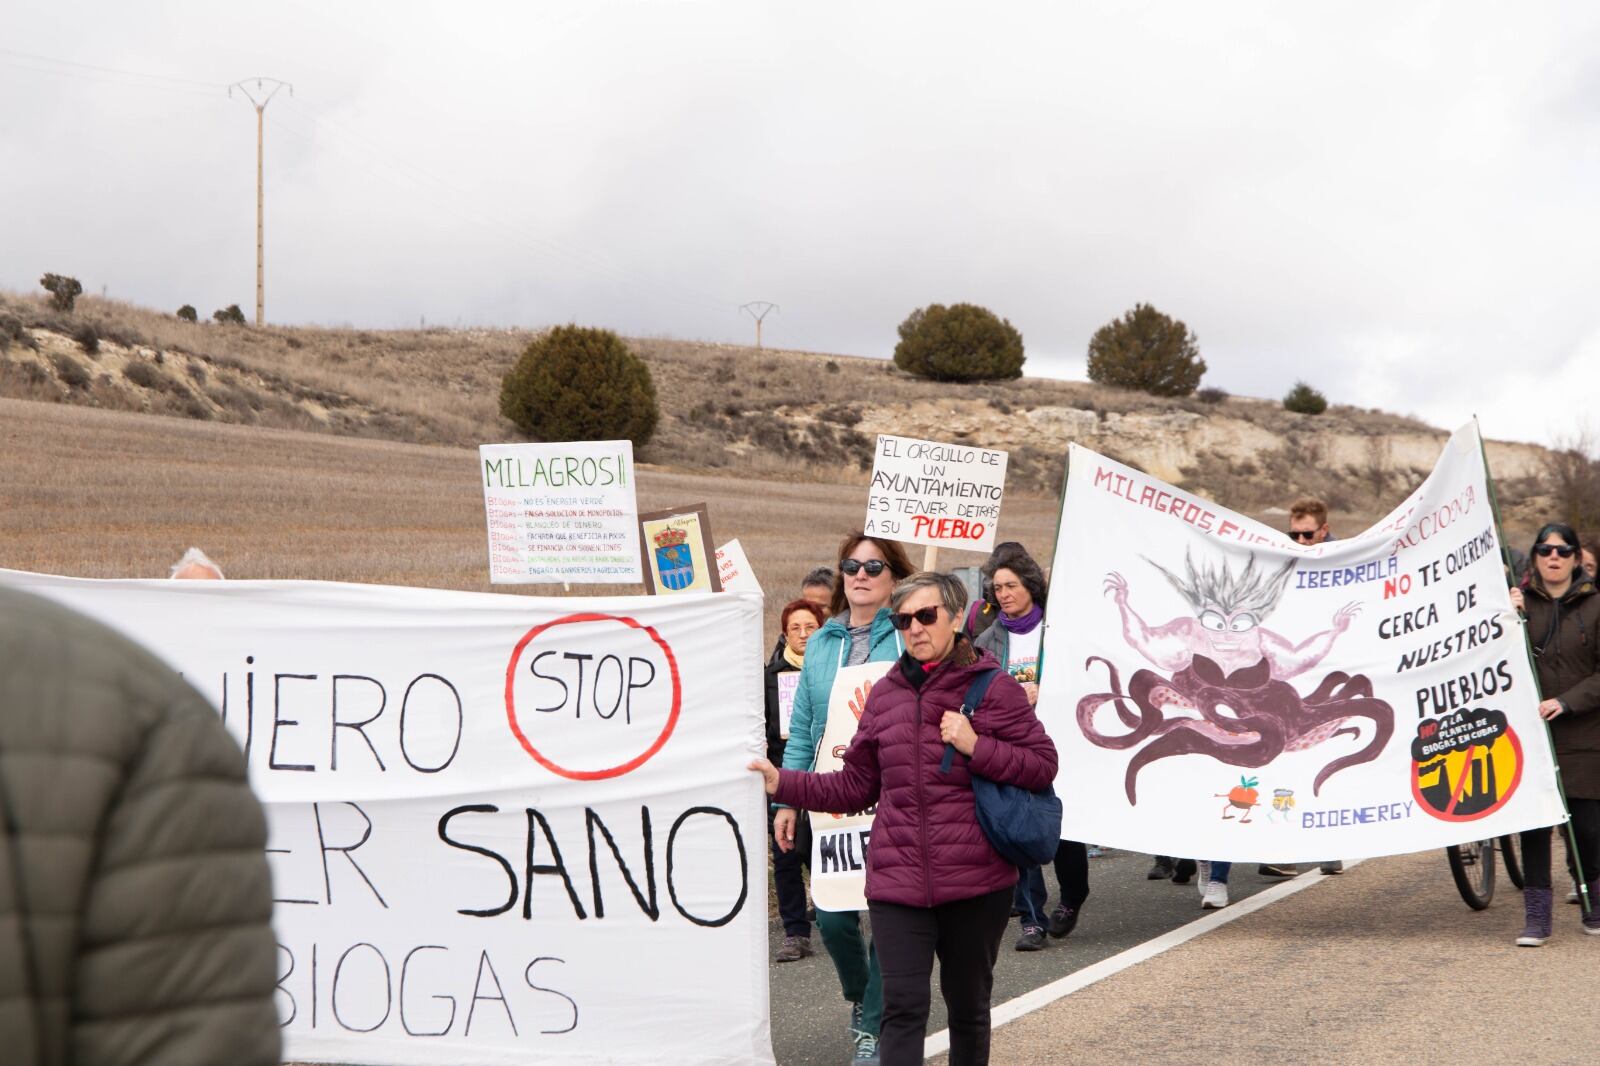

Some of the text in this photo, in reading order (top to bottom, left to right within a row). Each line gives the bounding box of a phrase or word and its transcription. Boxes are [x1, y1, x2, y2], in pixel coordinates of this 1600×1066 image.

[907, 444, 975, 463] ORGULLO
[981, 452, 1000, 465] DE
[923, 464, 945, 476] UN
[869, 496, 890, 512] ES
[896, 498, 948, 515] TENER
[1390, 485, 1476, 556] ACCIONA
[866, 519, 875, 533] A
[881, 520, 900, 533] SU
[1296, 557, 1398, 589] IBERDROLA
[1383, 525, 1495, 600] NO TE QUEREMOS
[1378, 583, 1477, 640] CERCA DE
[1396, 613, 1504, 673] NUESTROS
[530, 650, 656, 725] STOP
[1416, 659, 1513, 718] PUEBLOS
[1438, 717, 1488, 740] PLANTA DE
[1440, 720, 1448, 730] A
[1450, 713, 1464, 725] LA
[1422, 738, 1457, 755] BIOGAS
[1457, 734, 1471, 744] EN
[1302, 800, 1413, 829] BIOENERGY
[438, 804, 748, 928] SANO
